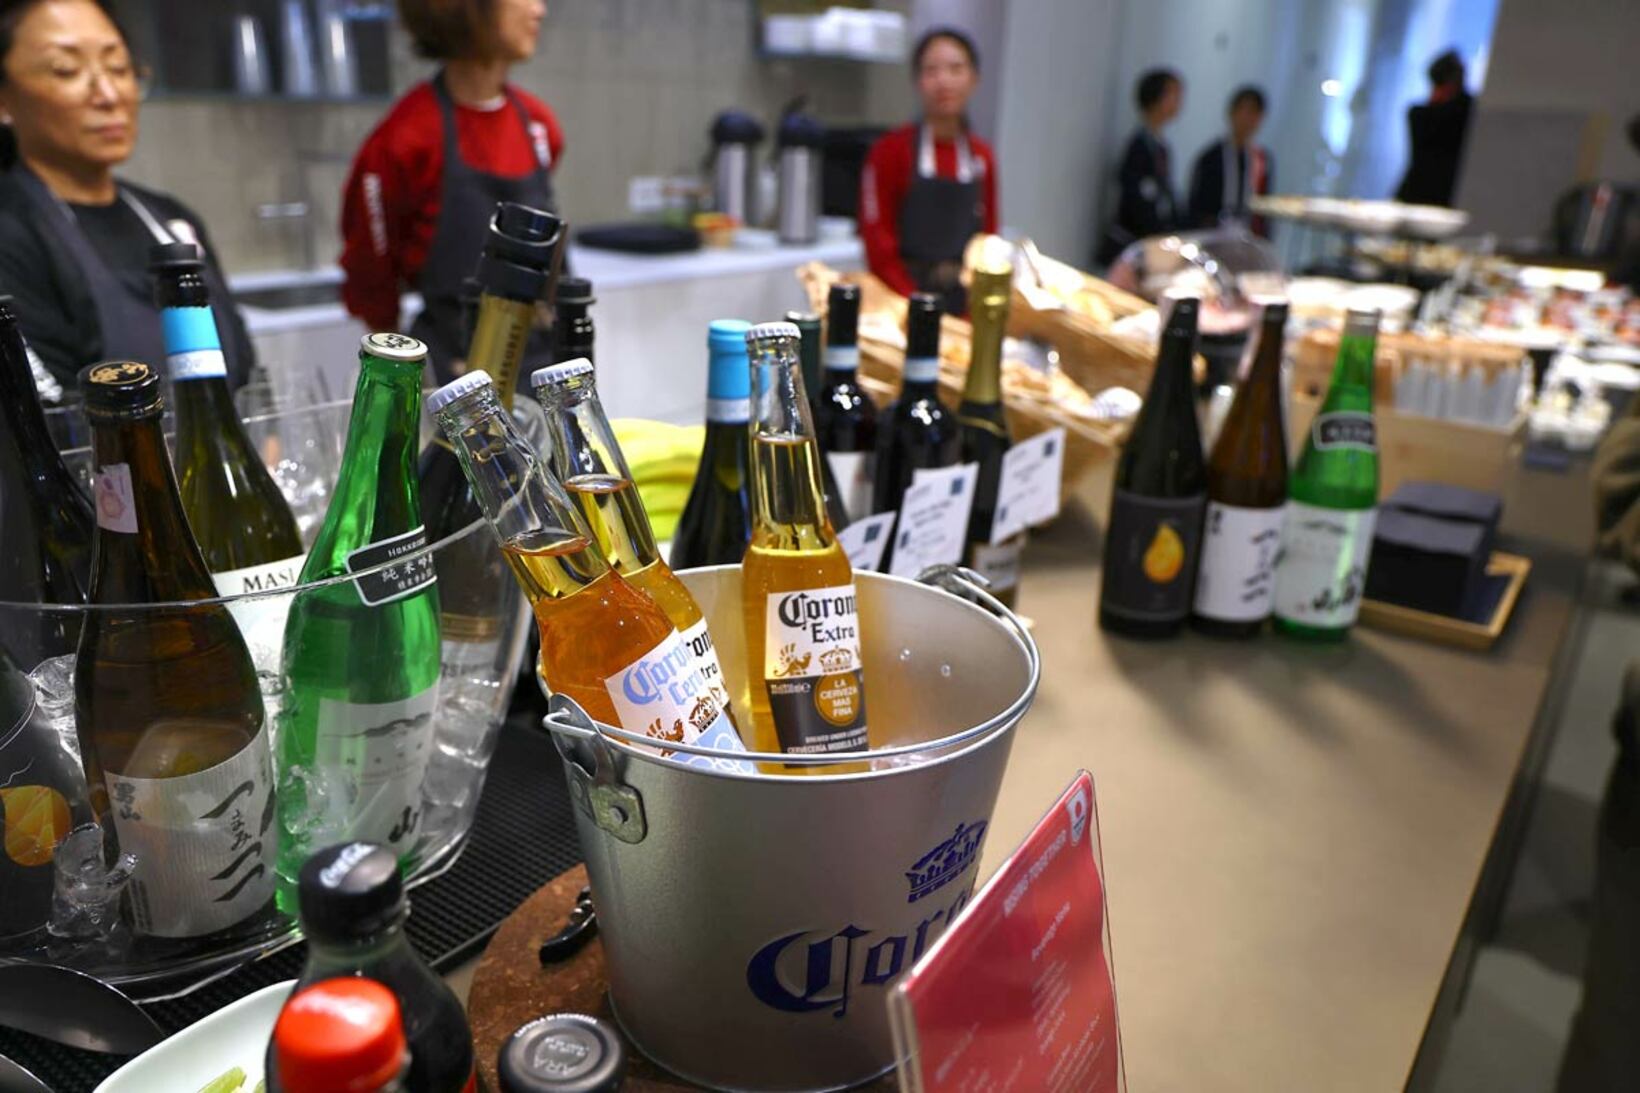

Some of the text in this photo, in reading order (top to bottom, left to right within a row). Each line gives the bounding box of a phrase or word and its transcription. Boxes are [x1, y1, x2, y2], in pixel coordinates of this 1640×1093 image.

[243, 567, 295, 594] MASI
[778, 592, 858, 631] Coron
[811, 621, 855, 644] Extra
[820, 686, 859, 700] CERVEZA
[834, 678, 847, 688] LA
